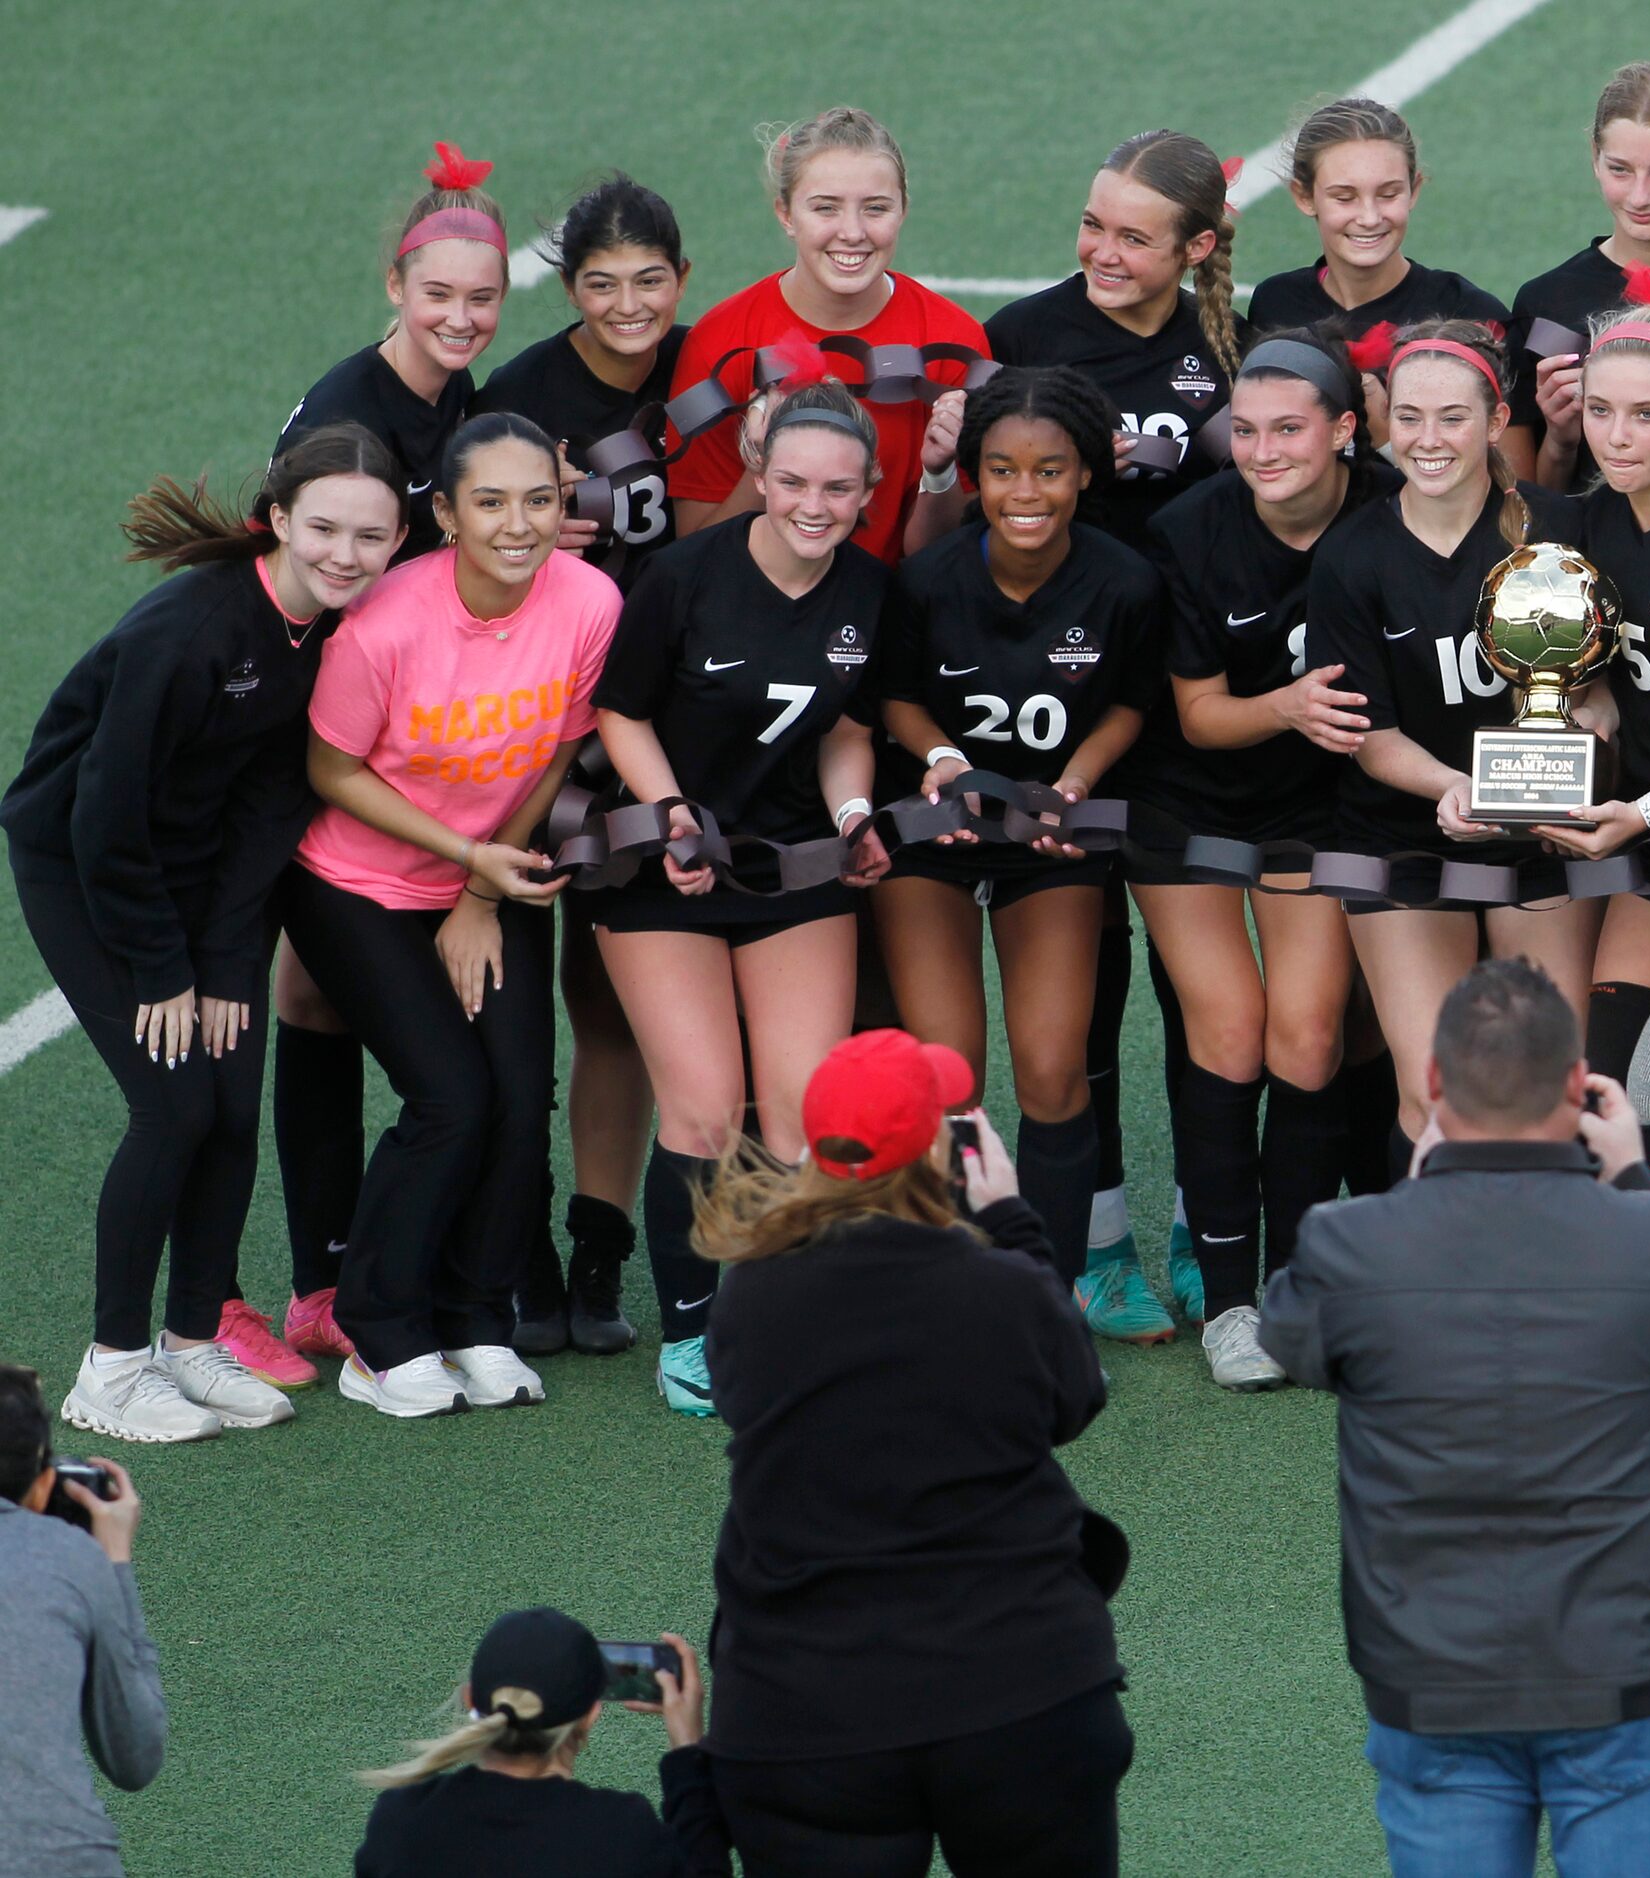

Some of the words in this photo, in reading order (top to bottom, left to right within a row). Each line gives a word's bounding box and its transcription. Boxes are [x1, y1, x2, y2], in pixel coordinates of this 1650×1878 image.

[1435, 630, 1508, 705] 10
[757, 683, 817, 744] 7
[962, 693, 1068, 751] 20
[407, 732, 559, 785] SOCCE
[1489, 772, 1521, 780] MARCUS
[1490, 759, 1575, 773] CHAMPION
